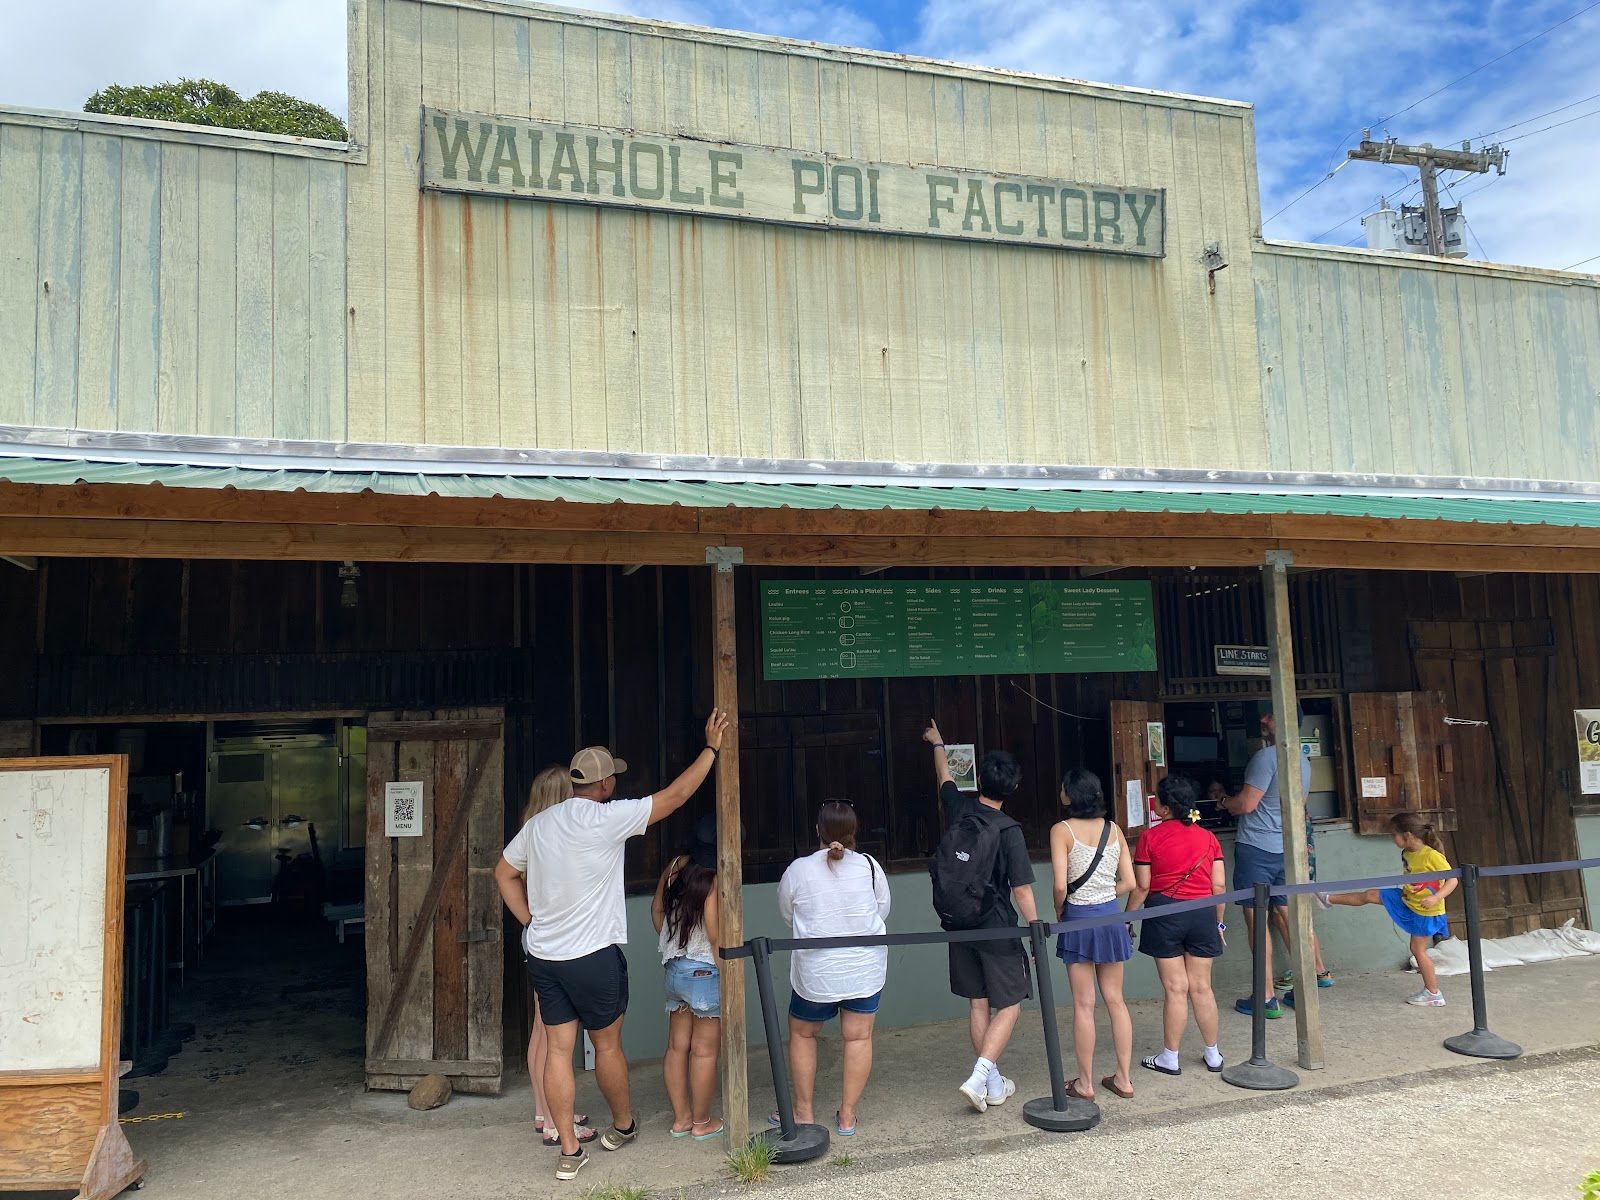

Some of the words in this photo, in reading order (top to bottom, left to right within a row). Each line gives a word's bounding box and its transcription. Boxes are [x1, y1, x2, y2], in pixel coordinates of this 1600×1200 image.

[433, 116, 744, 208] WAIAHOLE
[791, 158, 881, 223] POI
[925, 174, 1156, 246] FACTORY
[1220, 649, 1240, 659] LINE
[1241, 650, 1268, 660] STARTS
